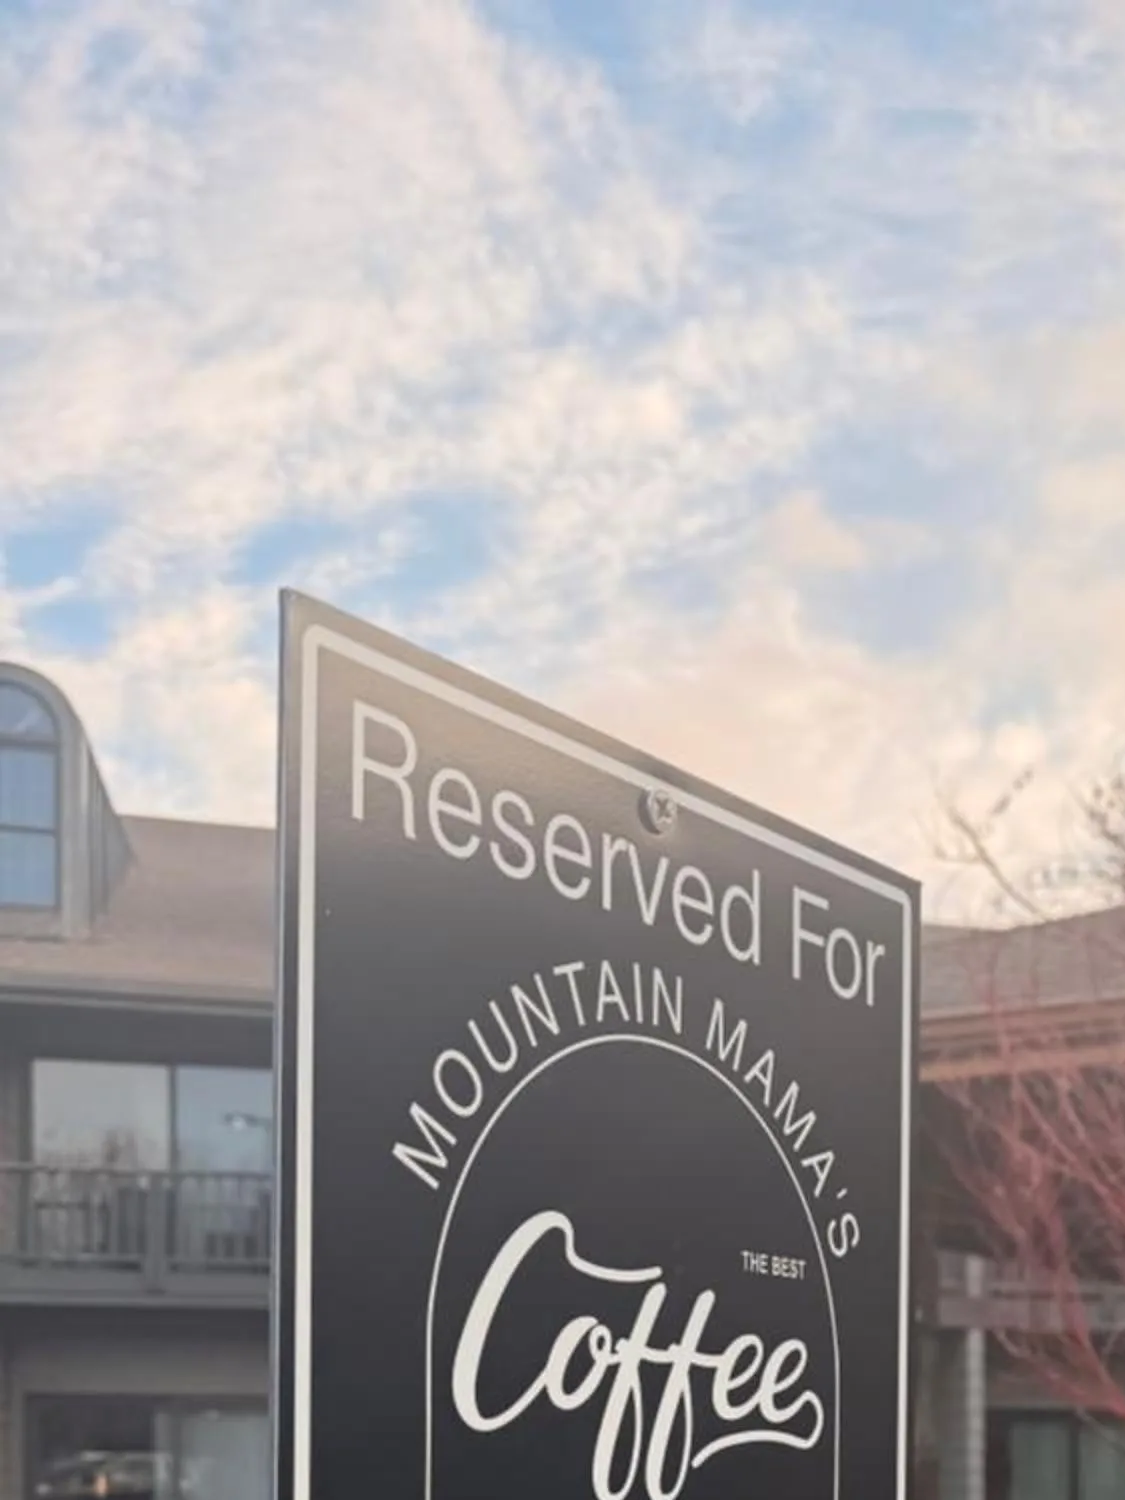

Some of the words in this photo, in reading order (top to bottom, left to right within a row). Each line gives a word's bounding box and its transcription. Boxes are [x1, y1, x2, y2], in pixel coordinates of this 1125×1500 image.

[350, 700, 762, 966] Reserved
[791, 885, 885, 1007] For
[392, 959, 683, 1191] MOUNTAIN
[704, 998, 860, 1258] MAMA'S
[741, 1250, 769, 1276] THE
[771, 1254, 807, 1281] BEST
